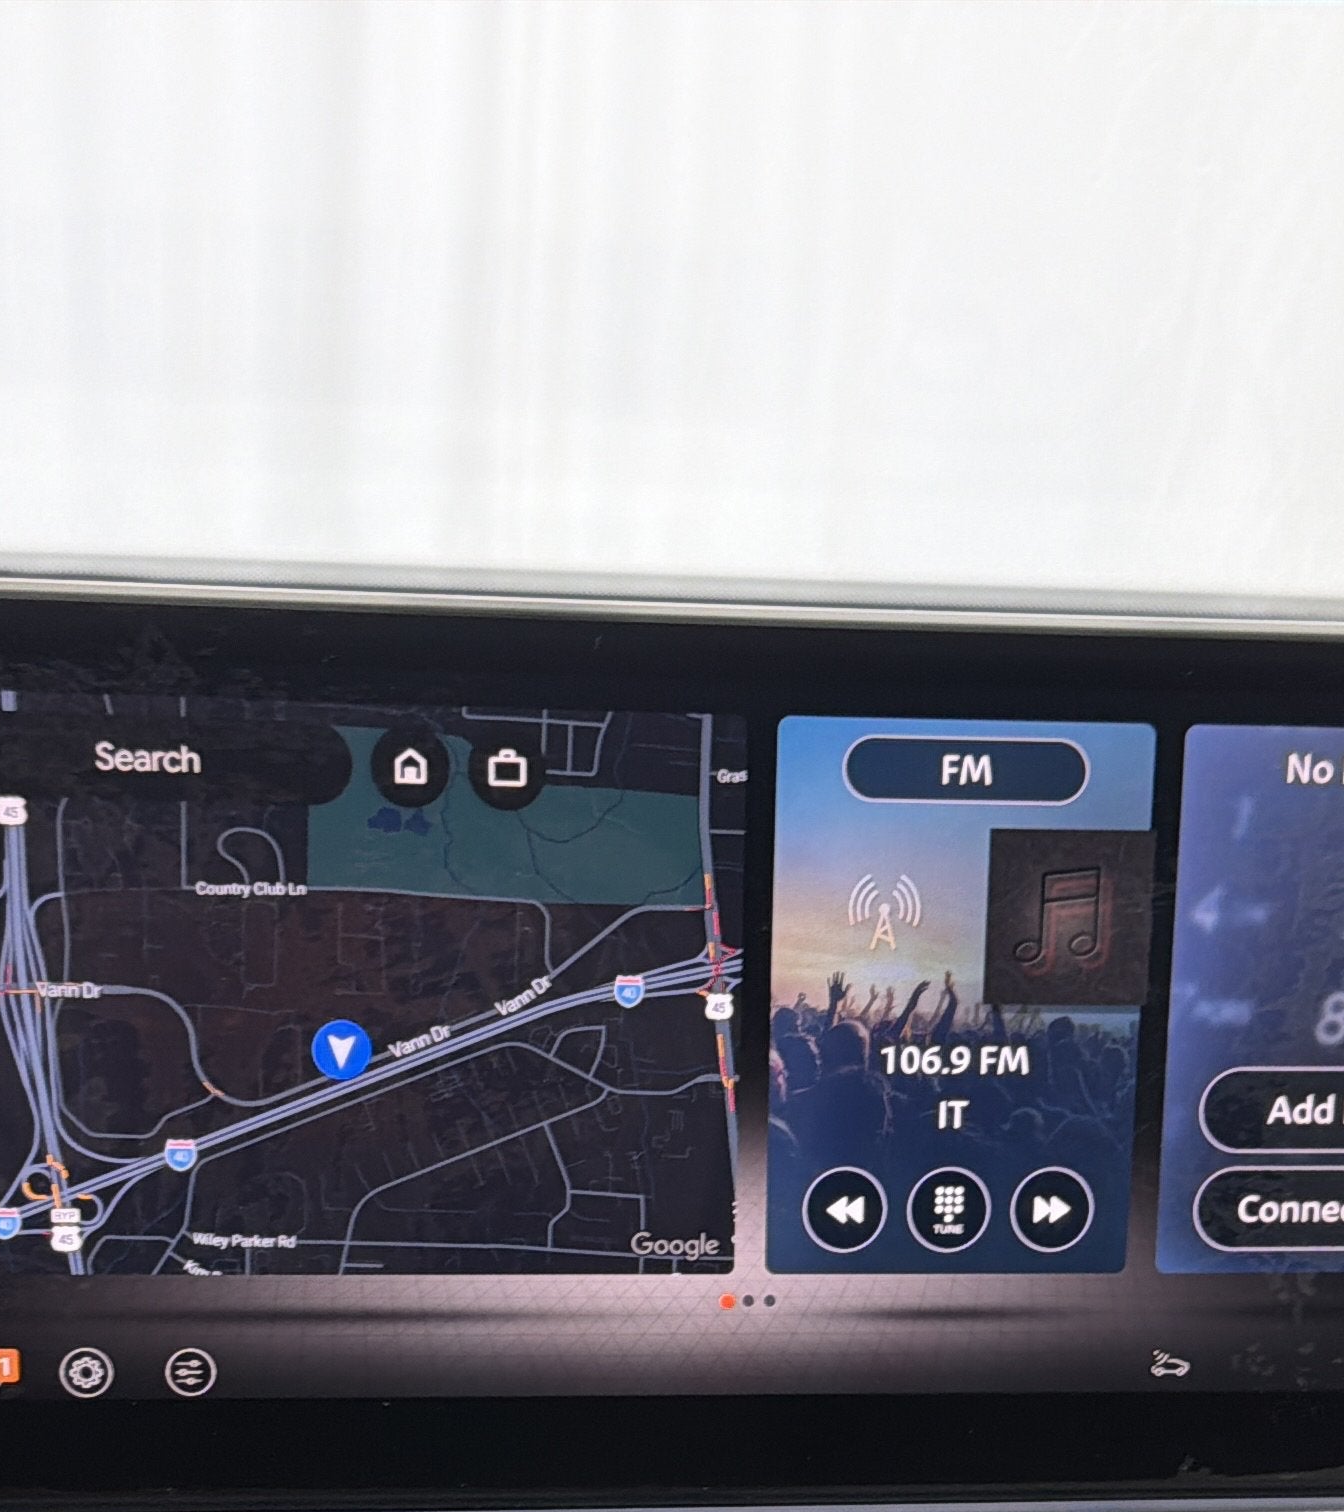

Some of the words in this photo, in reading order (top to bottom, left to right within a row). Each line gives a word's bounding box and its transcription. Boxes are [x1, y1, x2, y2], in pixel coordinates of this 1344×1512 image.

[94, 741, 202, 776] Search
[940, 755, 994, 788] FM
[1286, 753, 1335, 786] No
[194, 880, 251, 899] Country
[253, 880, 287, 896] Club
[288, 882, 308, 896] Ln
[36, 981, 77, 999] Vann
[80, 981, 103, 999] Dr
[494, 987, 533, 1016] Vann
[531, 976, 553, 996] Dr
[388, 1034, 431, 1058] Vann
[430, 1025, 452, 1044] Dr
[880, 1044, 970, 1076] 106.9
[978, 1045, 1030, 1075] FM
[937, 1099, 969, 1131] IT
[1266, 1092, 1338, 1126] Add
[192, 1232, 229, 1249] Wiley
[230, 1233, 276, 1249] Parker
[277, 1235, 297, 1249] Rd
[932, 1222, 964, 1236] TUNE
[630, 1231, 721, 1262] Google
